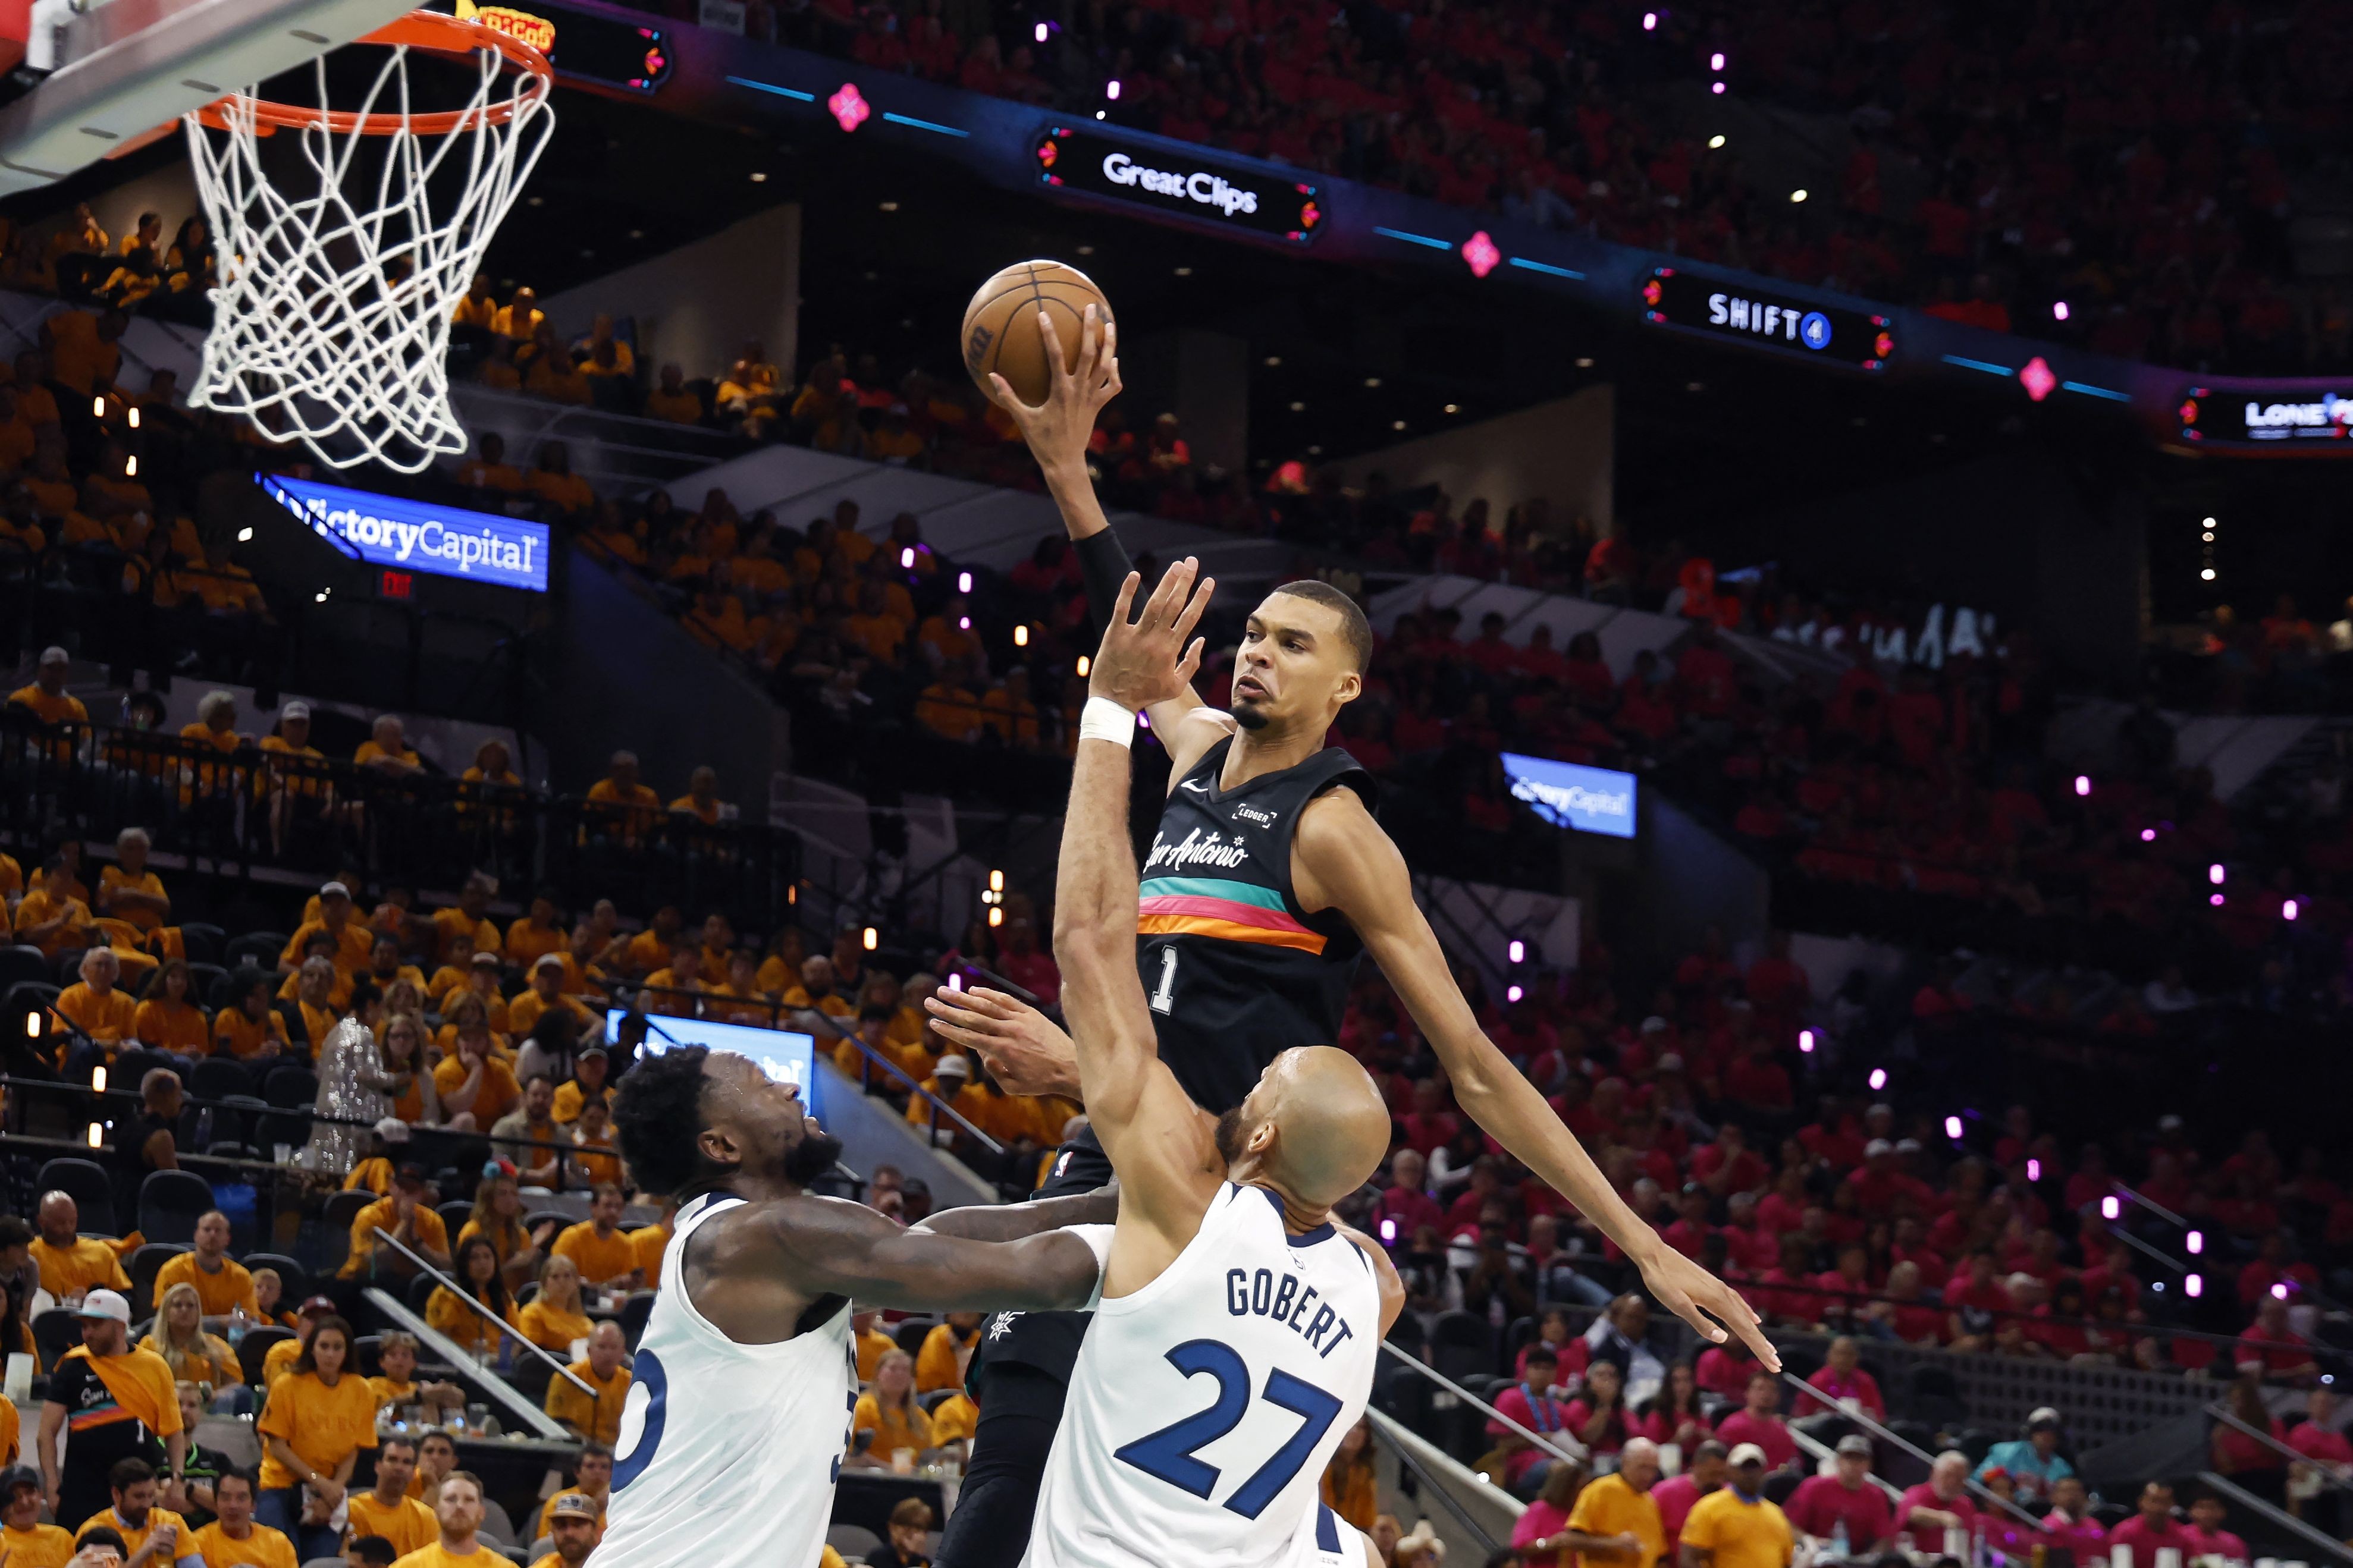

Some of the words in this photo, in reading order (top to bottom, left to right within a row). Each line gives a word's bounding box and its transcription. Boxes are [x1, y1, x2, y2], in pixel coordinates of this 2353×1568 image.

[1165, 827, 1248, 871] Antonio
[1238, 807, 1269, 823] LEDGER
[1150, 945, 1178, 1016] 1
[1226, 1268, 1353, 1359] GOBERT
[1113, 1338, 1344, 1520] 27
